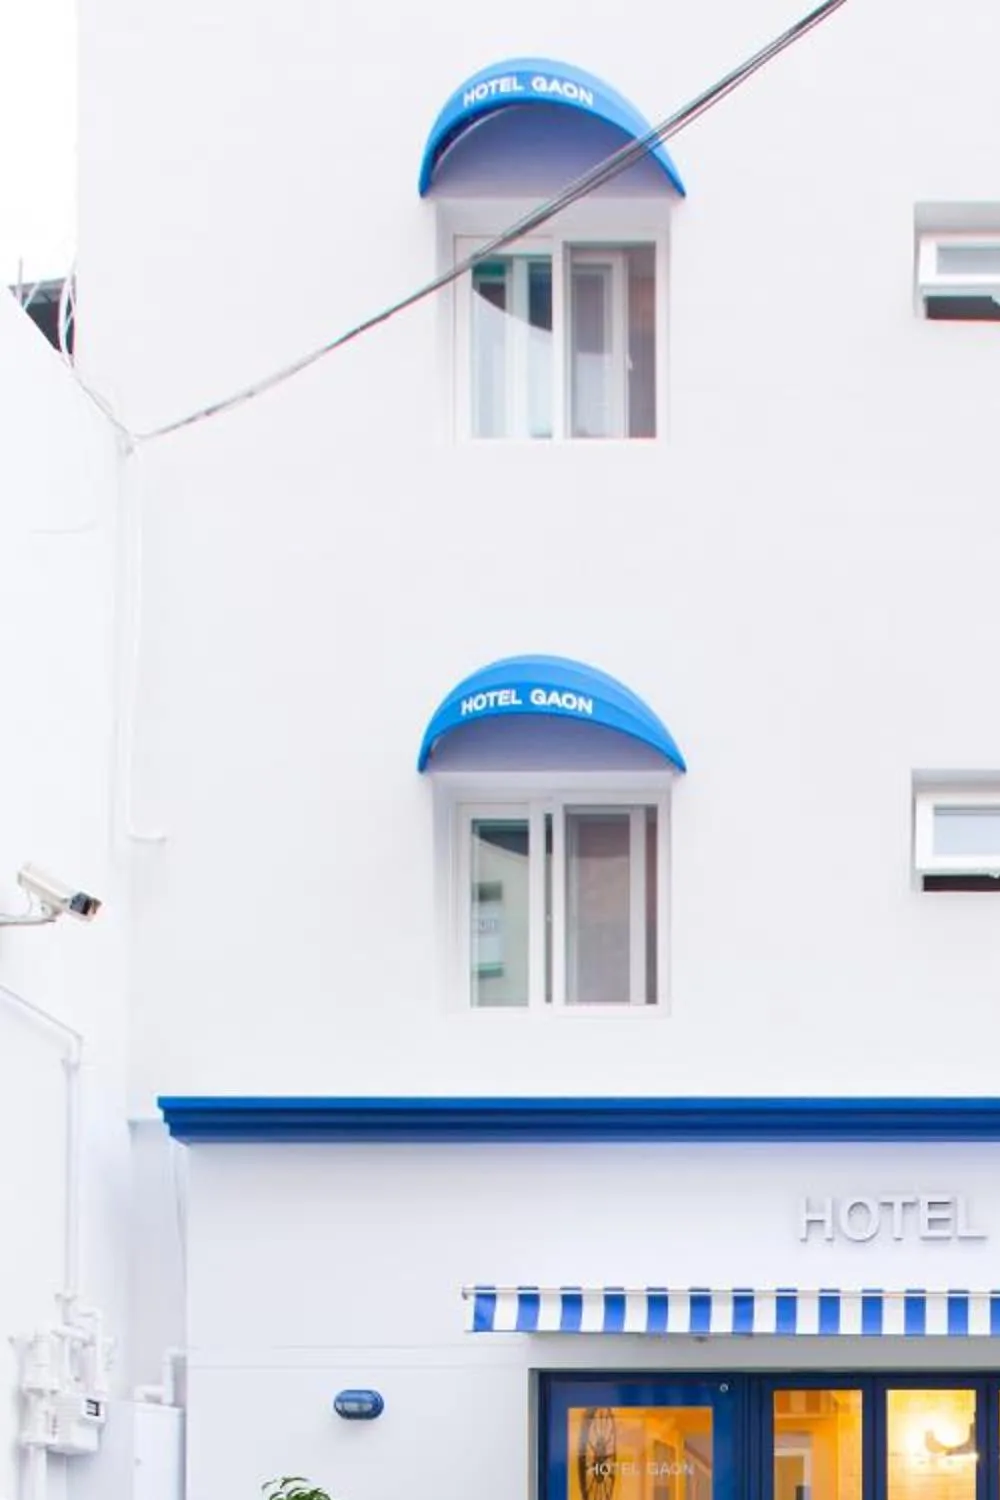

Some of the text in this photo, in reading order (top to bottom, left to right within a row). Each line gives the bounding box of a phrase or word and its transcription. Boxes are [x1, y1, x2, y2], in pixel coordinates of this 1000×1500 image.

[463, 76, 594, 107] HOTEL GAON
[460, 688, 593, 716] HOTEL GAON
[800, 1196, 988, 1242] HOTEL
